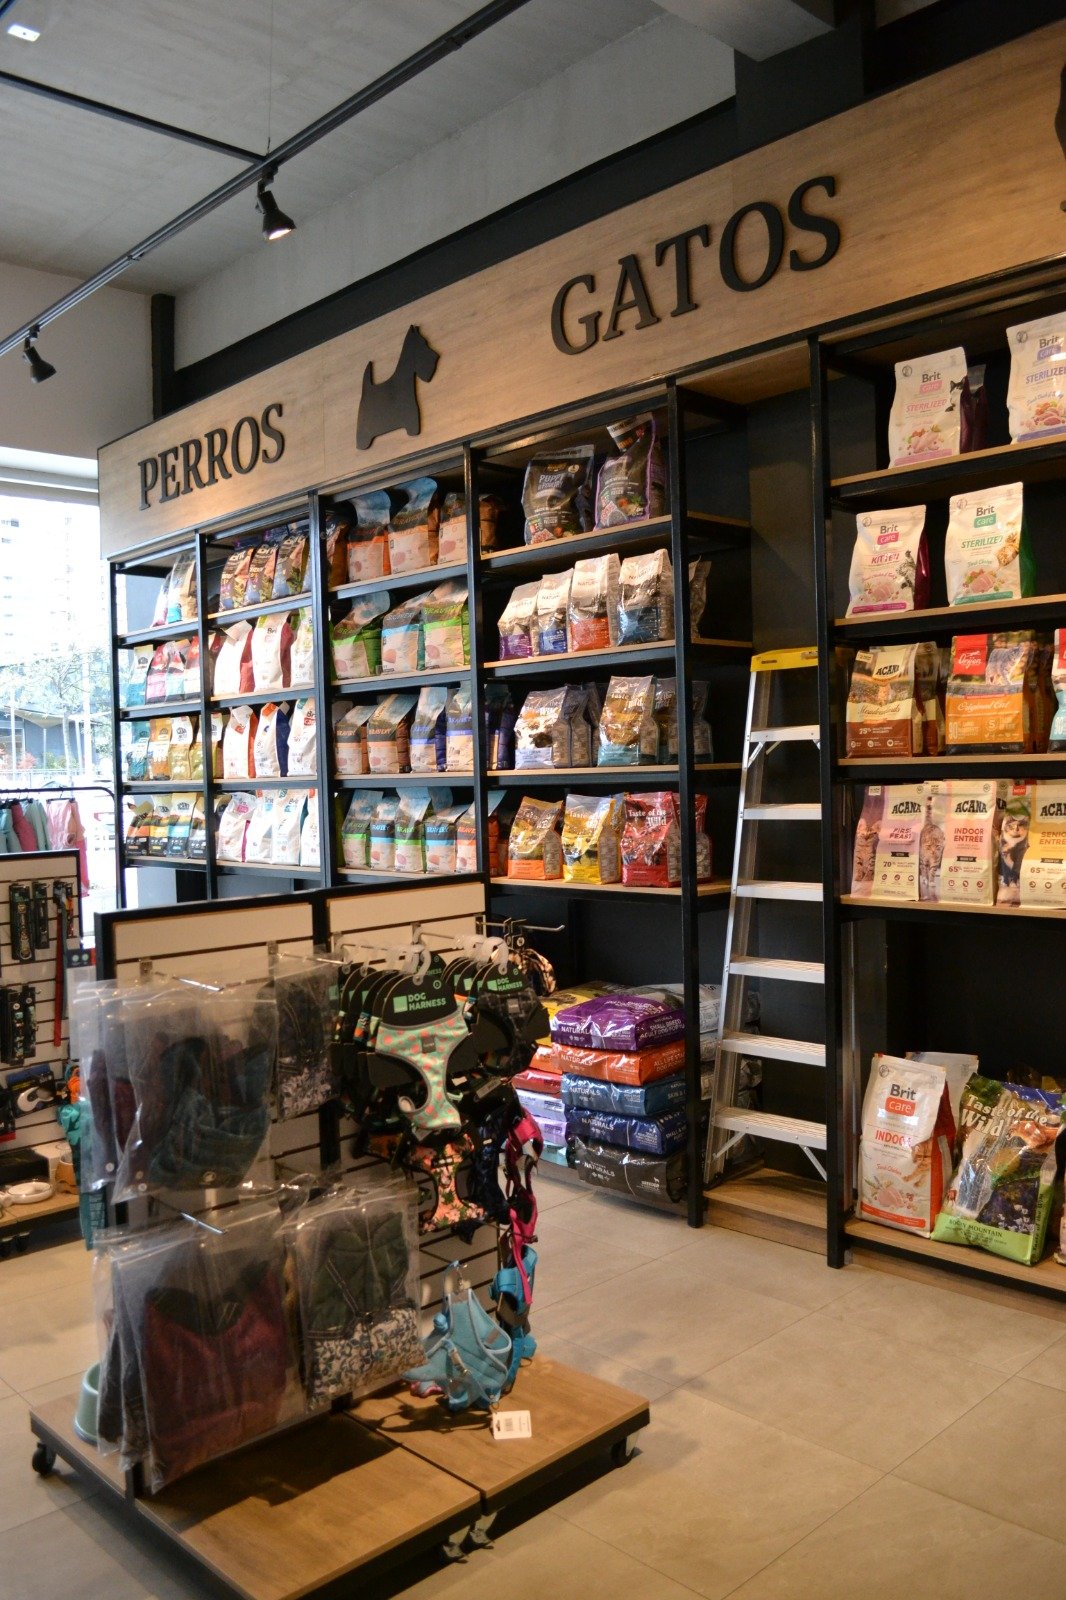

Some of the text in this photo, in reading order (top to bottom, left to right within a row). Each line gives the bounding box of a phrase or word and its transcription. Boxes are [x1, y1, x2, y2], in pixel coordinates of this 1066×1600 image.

[550, 175, 843, 356] GATOS
[1039, 335, 1060, 349] Brit
[922, 371, 942, 383] Brit
[138, 403, 286, 511] PERROS
[976, 505, 995, 517] Brit
[976, 516, 995, 526] care
[880, 524, 899, 534] Brit
[880, 534, 896, 543] care
[891, 801, 922, 814] ACANA
[955, 799, 988, 813] ACANA
[628, 809, 646, 818] Taste
[646, 816, 667, 827] Wild
[953, 827, 984, 835] INDOOR
[497, 977, 510, 985] DOG
[497, 981, 523, 991] HARNESS
[408, 991, 427, 1002] DOG
[408, 997, 447, 1011] HARNESS
[569, 1086, 601, 1097] NATURALS
[889, 1083, 917, 1101] Brit
[888, 1100, 912, 1113] care
[966, 1093, 1049, 1127] Taste of the
[581, 1117, 615, 1131] NATURALS
[960, 1108, 1005, 1138] Wild
[583, 1161, 616, 1178] NATURALS
[968, 1224, 1004, 1238] MOUNTAIN
